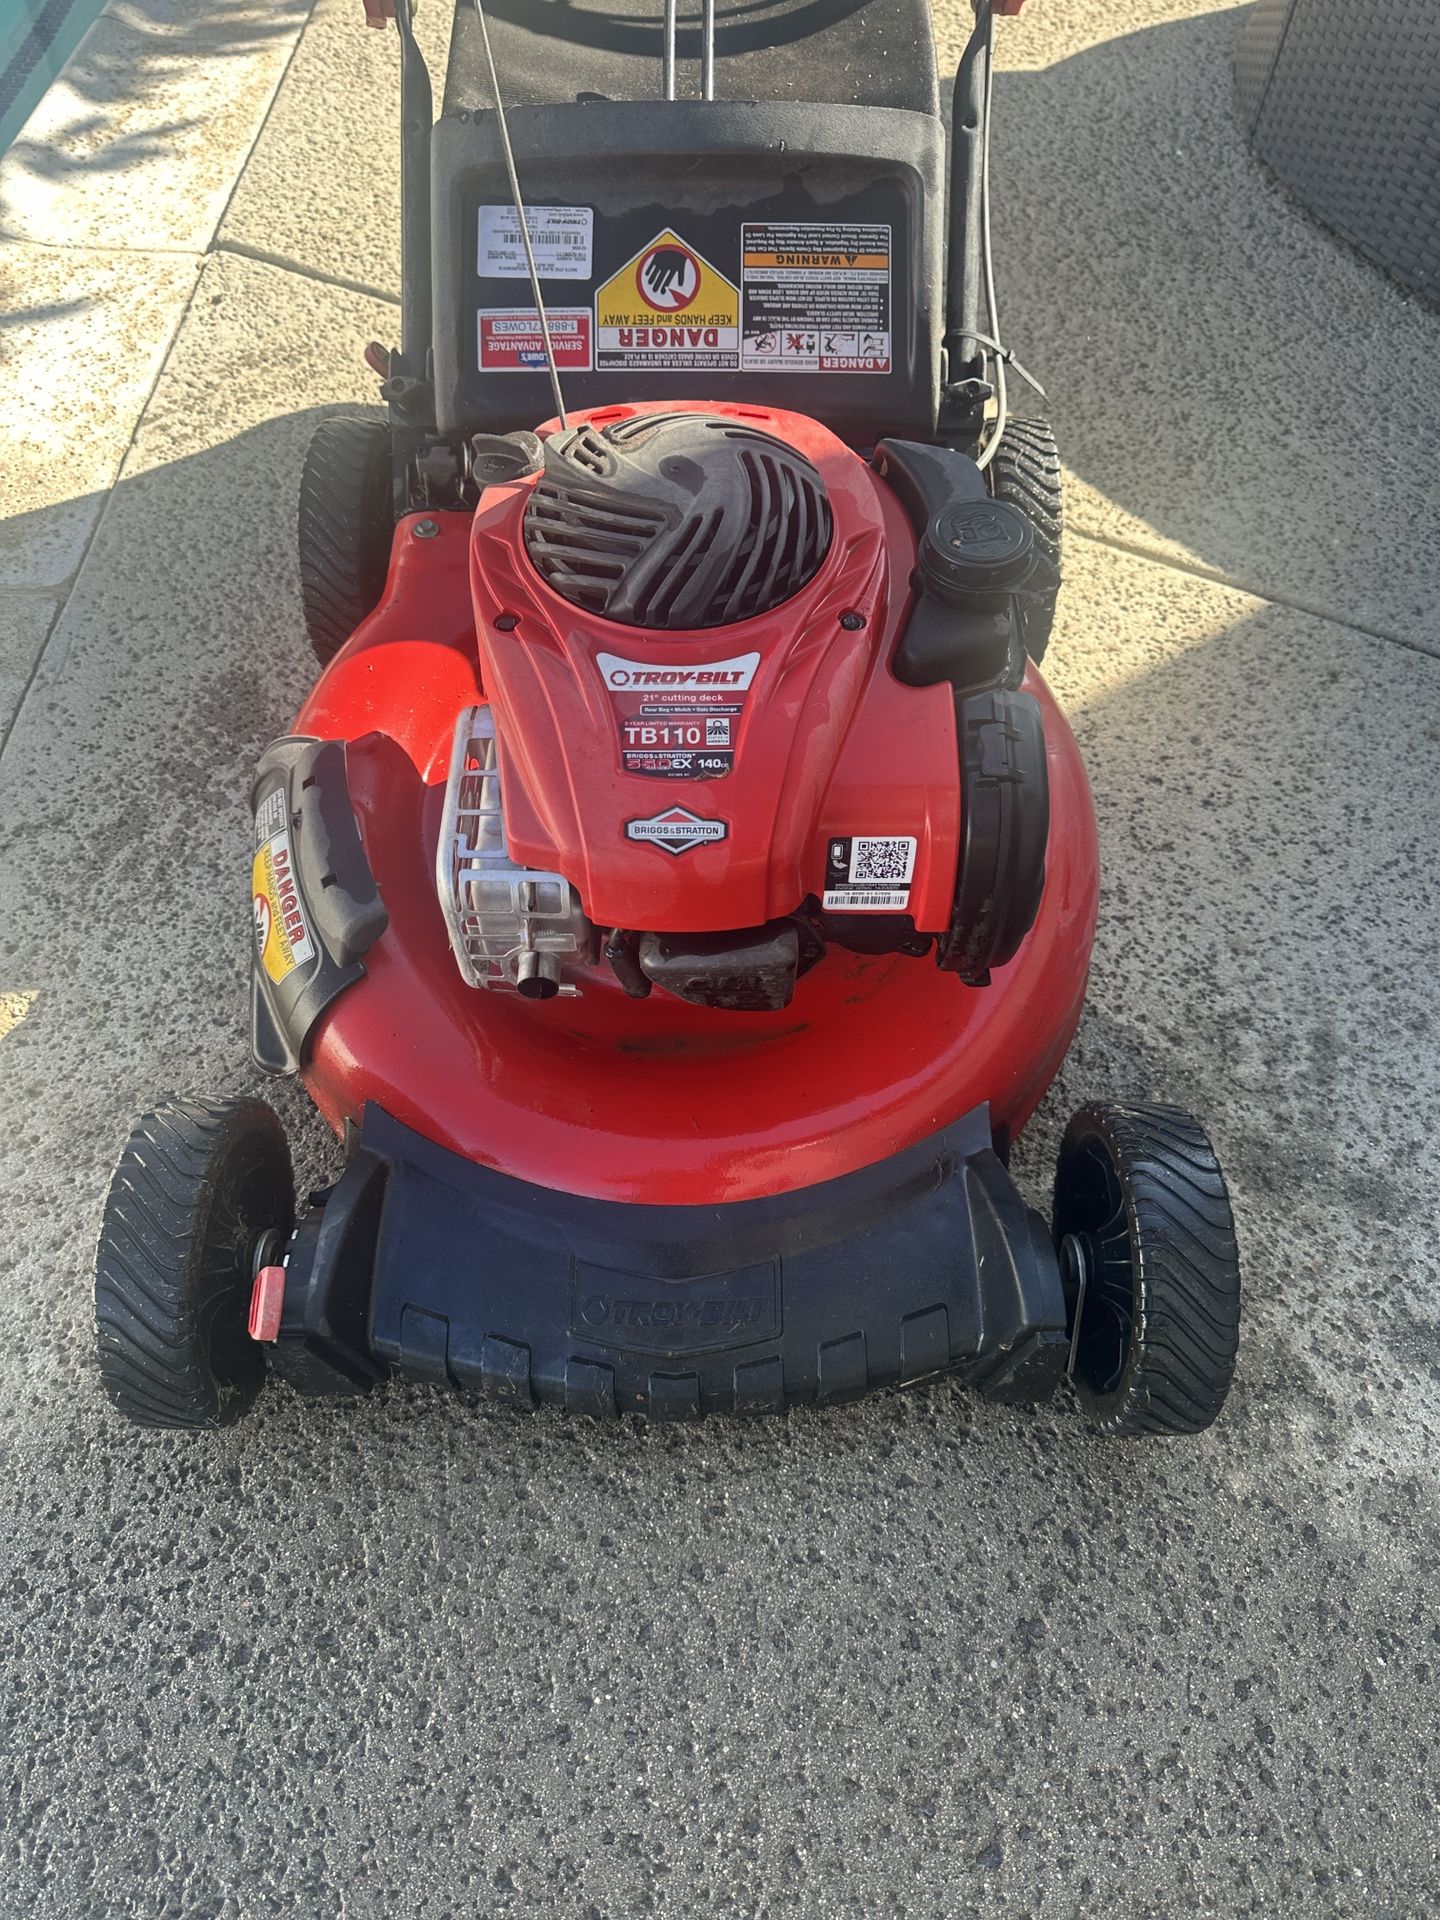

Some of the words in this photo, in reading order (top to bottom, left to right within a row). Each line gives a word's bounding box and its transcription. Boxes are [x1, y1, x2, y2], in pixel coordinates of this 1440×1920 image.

[776, 255, 841, 266] WARNING
[603, 314, 630, 325] AWAY
[632, 314, 655, 325] FEET
[656, 314, 673, 325] and
[675, 314, 706, 325] HANDS
[708, 314, 732, 325] KEEP
[618, 328, 718, 347] DANGER
[488, 340, 542, 351] ADVANTAGE
[544, 340, 582, 351] SERVIC
[823, 358, 874, 368] DANGER
[632, 672, 744, 685] TROY-BILT
[662, 694, 697, 703] cutting
[624, 727, 700, 744] TB110
[266, 870, 278, 900] HANDS
[272, 849, 306, 946] DANGER
[270, 901, 280, 916] and
[273, 916, 284, 939] FEET
[280, 938, 294, 966] AWAY
